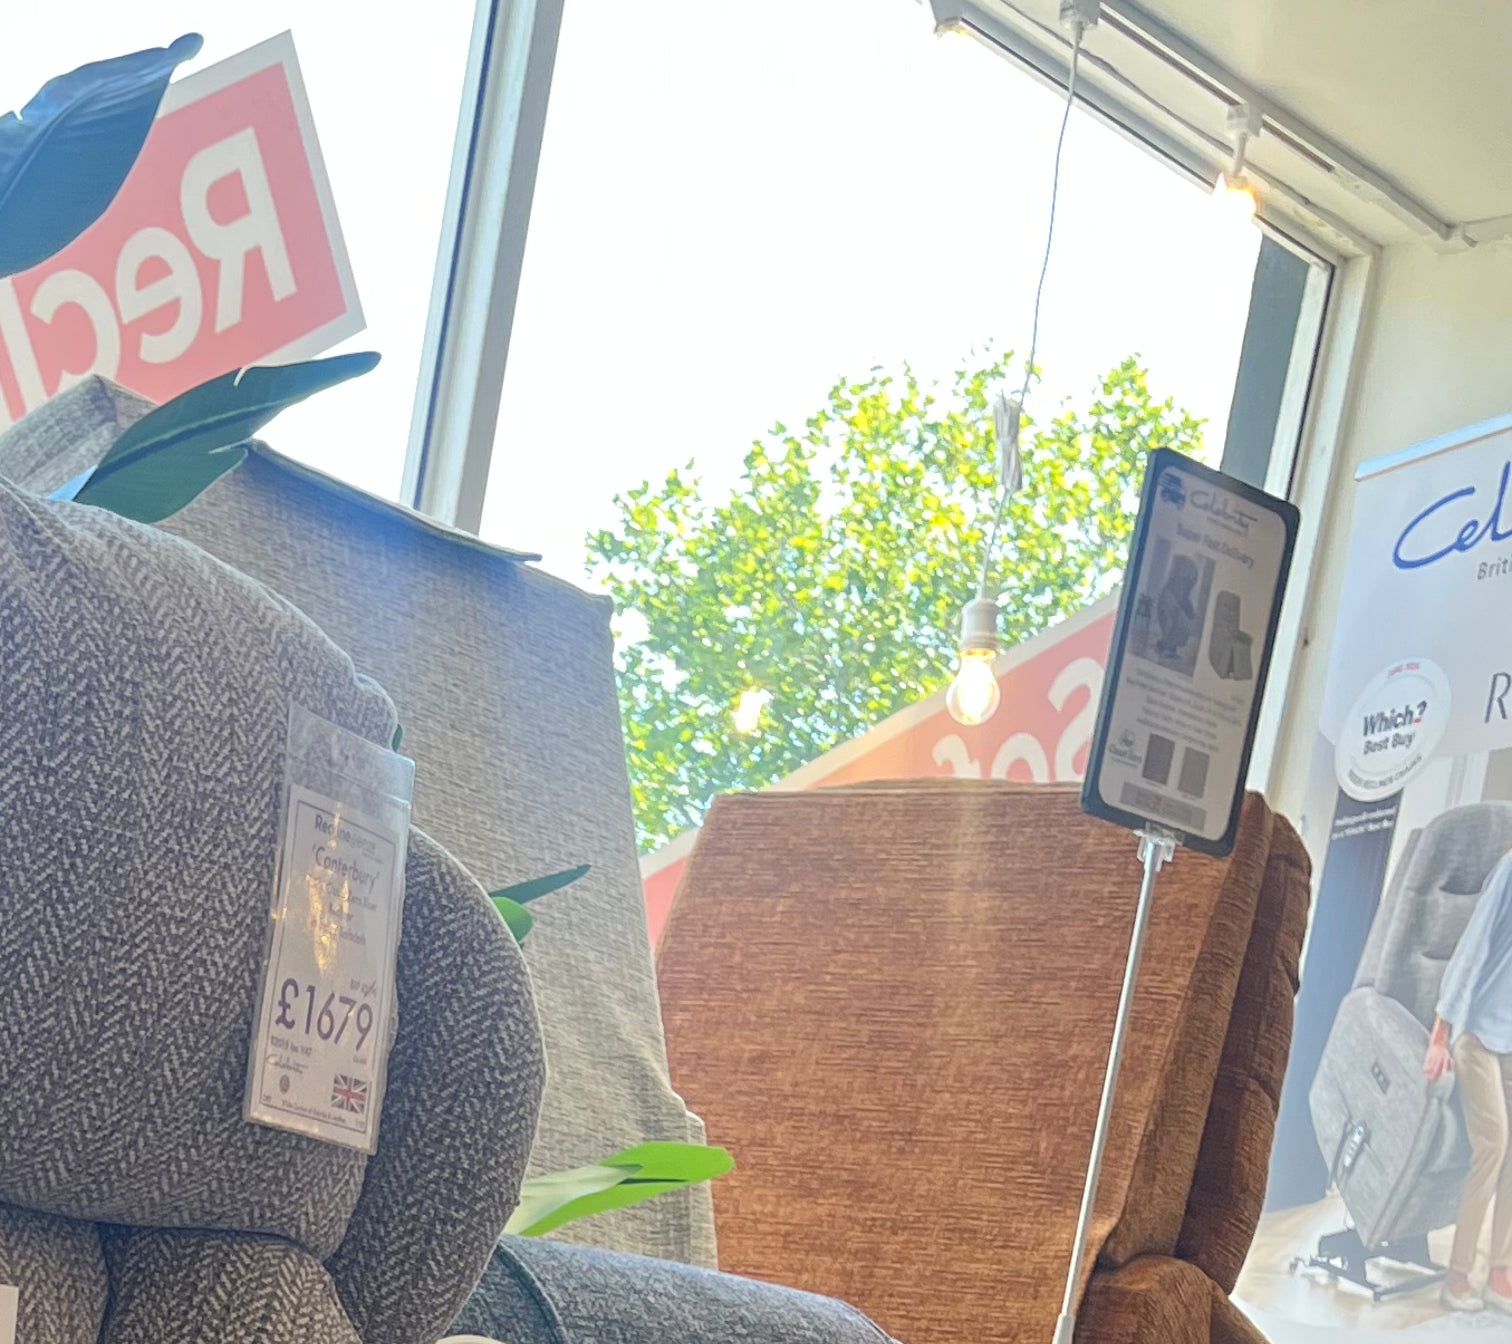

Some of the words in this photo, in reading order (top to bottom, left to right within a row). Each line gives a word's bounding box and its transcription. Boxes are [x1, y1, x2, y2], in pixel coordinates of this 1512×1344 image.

[1363, 700, 1427, 737] Which?
[1363, 739, 1389, 755] Best
[1391, 732, 1416, 749] Buy
[275, 978, 373, 1052] £1679
